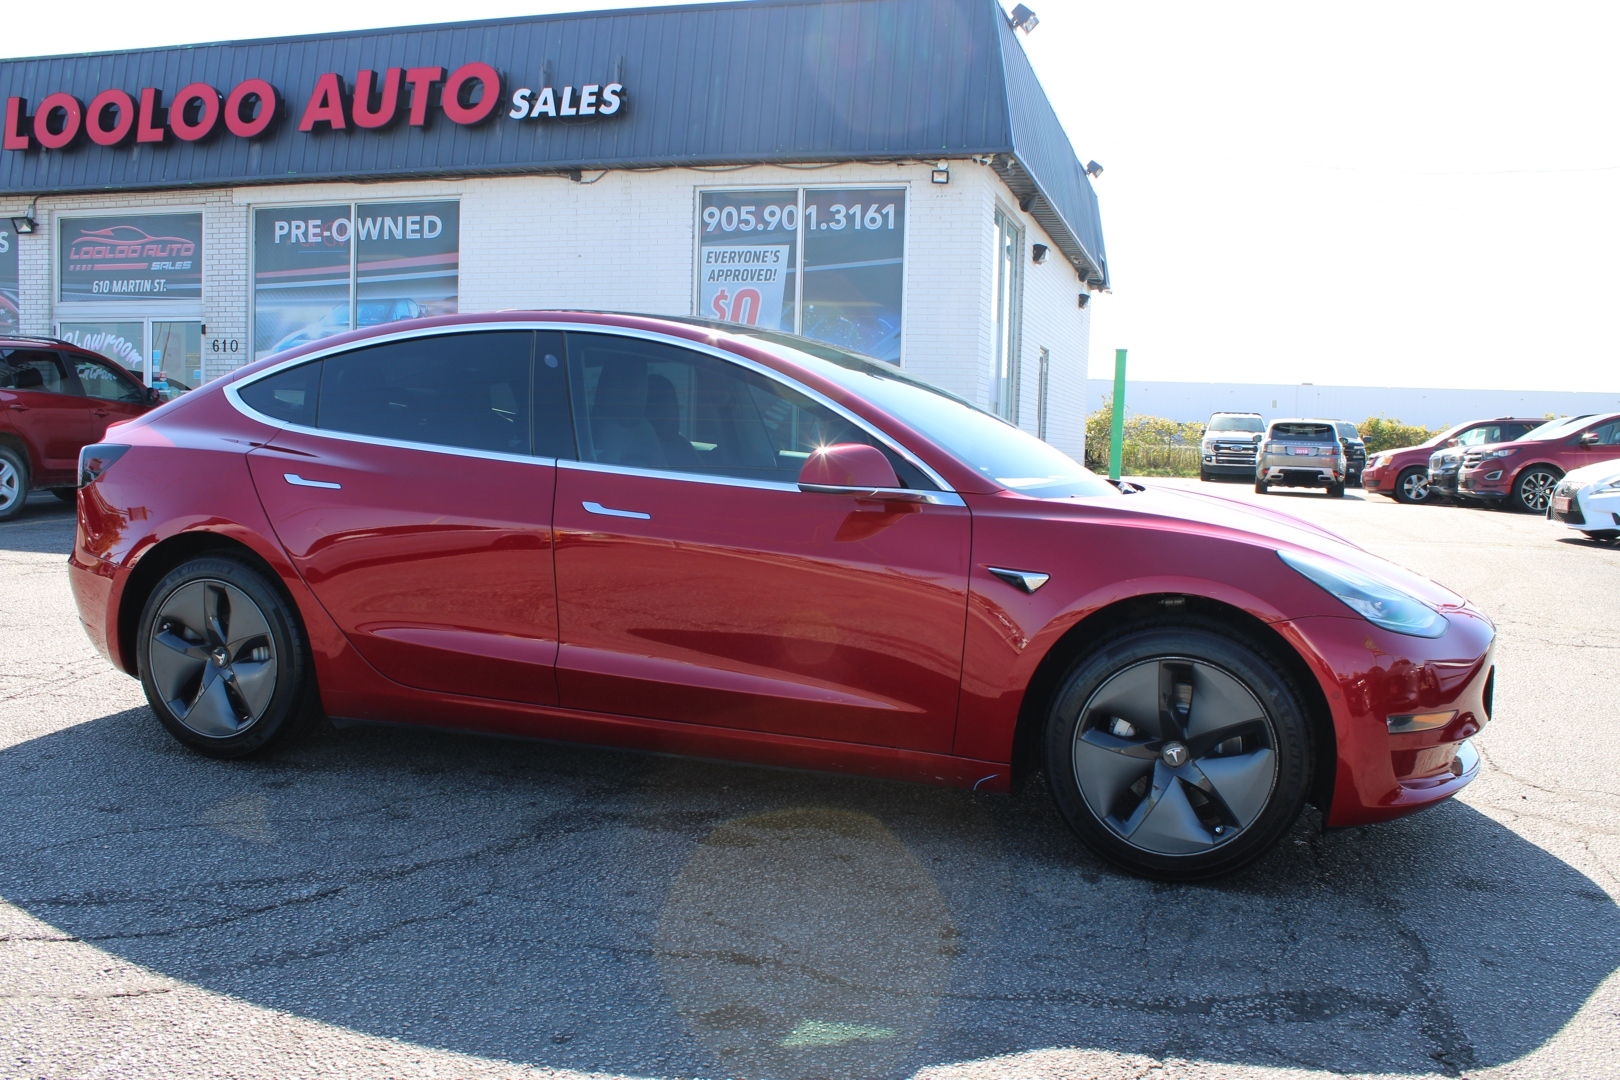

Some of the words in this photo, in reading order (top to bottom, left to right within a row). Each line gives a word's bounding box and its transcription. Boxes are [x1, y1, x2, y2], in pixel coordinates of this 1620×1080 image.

[4, 78, 278, 150] LOOLOO
[297, 62, 501, 132] AUTO
[509, 83, 623, 120] SALES
[703, 203, 895, 232] 905.901.3161
[273, 215, 443, 244] PRE-OWNED
[69, 245, 142, 260] LOOLOO
[142, 243, 196, 258] AUTO
[706, 249, 781, 264] EVERYONE'S
[150, 260, 193, 271] SALES
[707, 268, 778, 282] APPROVED!
[92, 280, 110, 294] 610
[111, 279, 152, 293] MARTIN
[153, 278, 167, 292] ST.
[212, 339, 239, 353] 610
